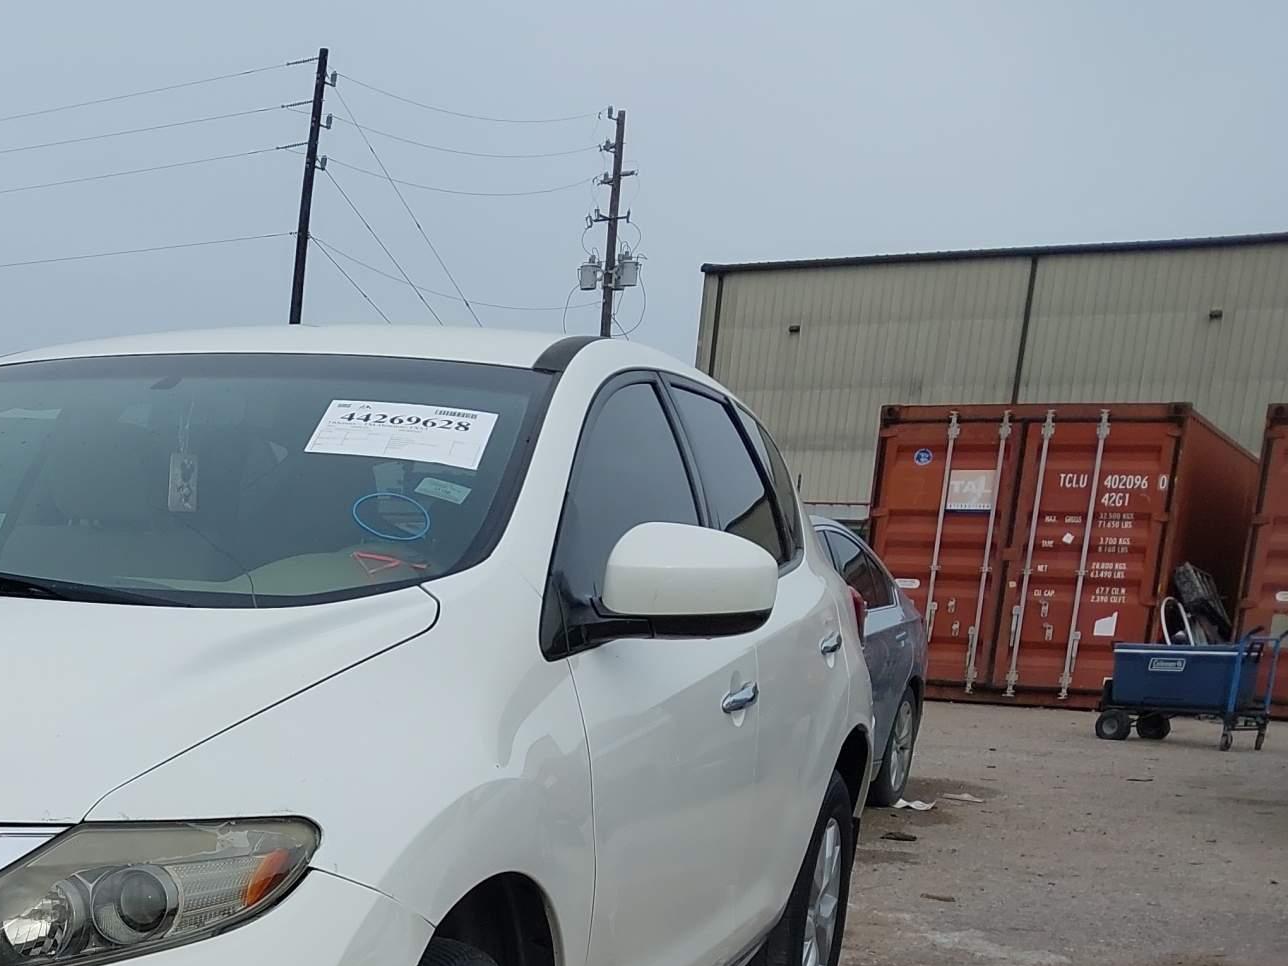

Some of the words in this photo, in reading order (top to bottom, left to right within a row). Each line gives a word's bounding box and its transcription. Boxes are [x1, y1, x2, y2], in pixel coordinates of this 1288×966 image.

[340, 412, 472, 432] 44269628
[1059, 473, 1088, 488] TCLU
[1103, 475, 1149, 489] 402096
[1159, 475, 1168, 490] 0
[1100, 492, 1130, 507] 42G1
